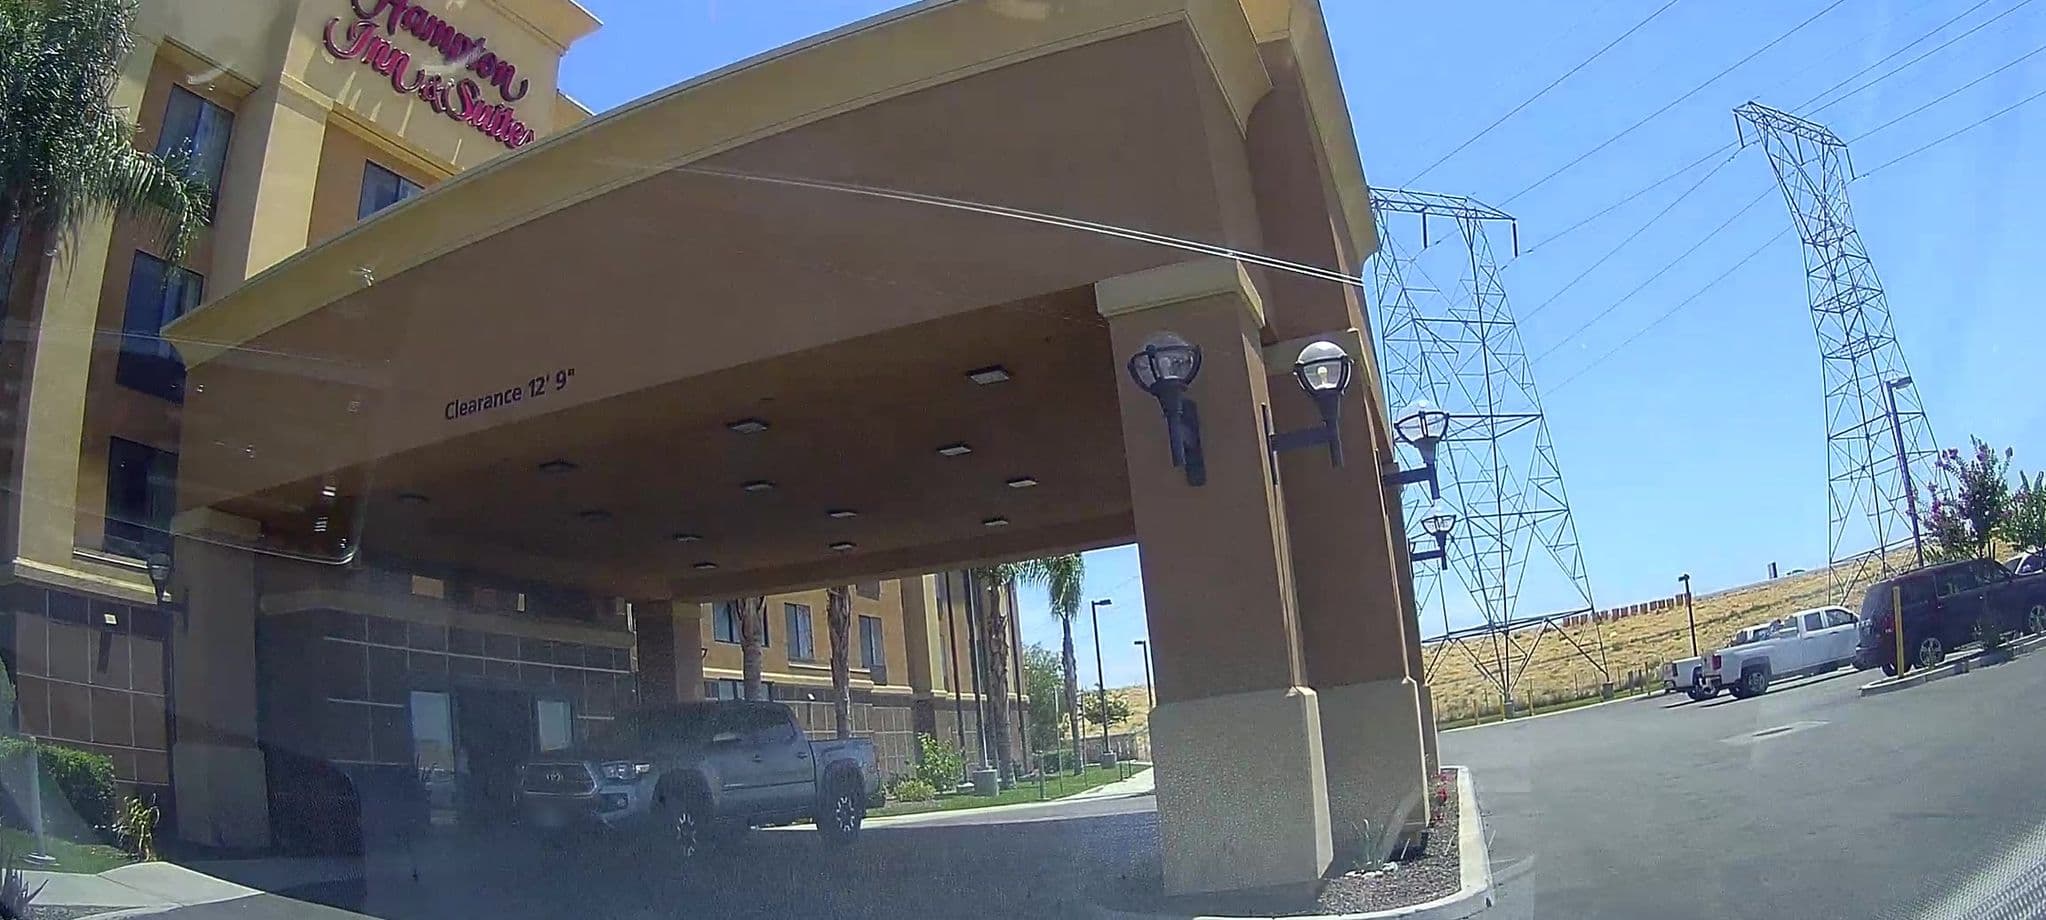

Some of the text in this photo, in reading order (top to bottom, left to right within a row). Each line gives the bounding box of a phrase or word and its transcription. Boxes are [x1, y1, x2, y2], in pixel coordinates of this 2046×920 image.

[323, 17, 426, 94] Inn
[418, 74, 447, 113] &
[444, 367, 576, 420] Clearance 12' 9"
